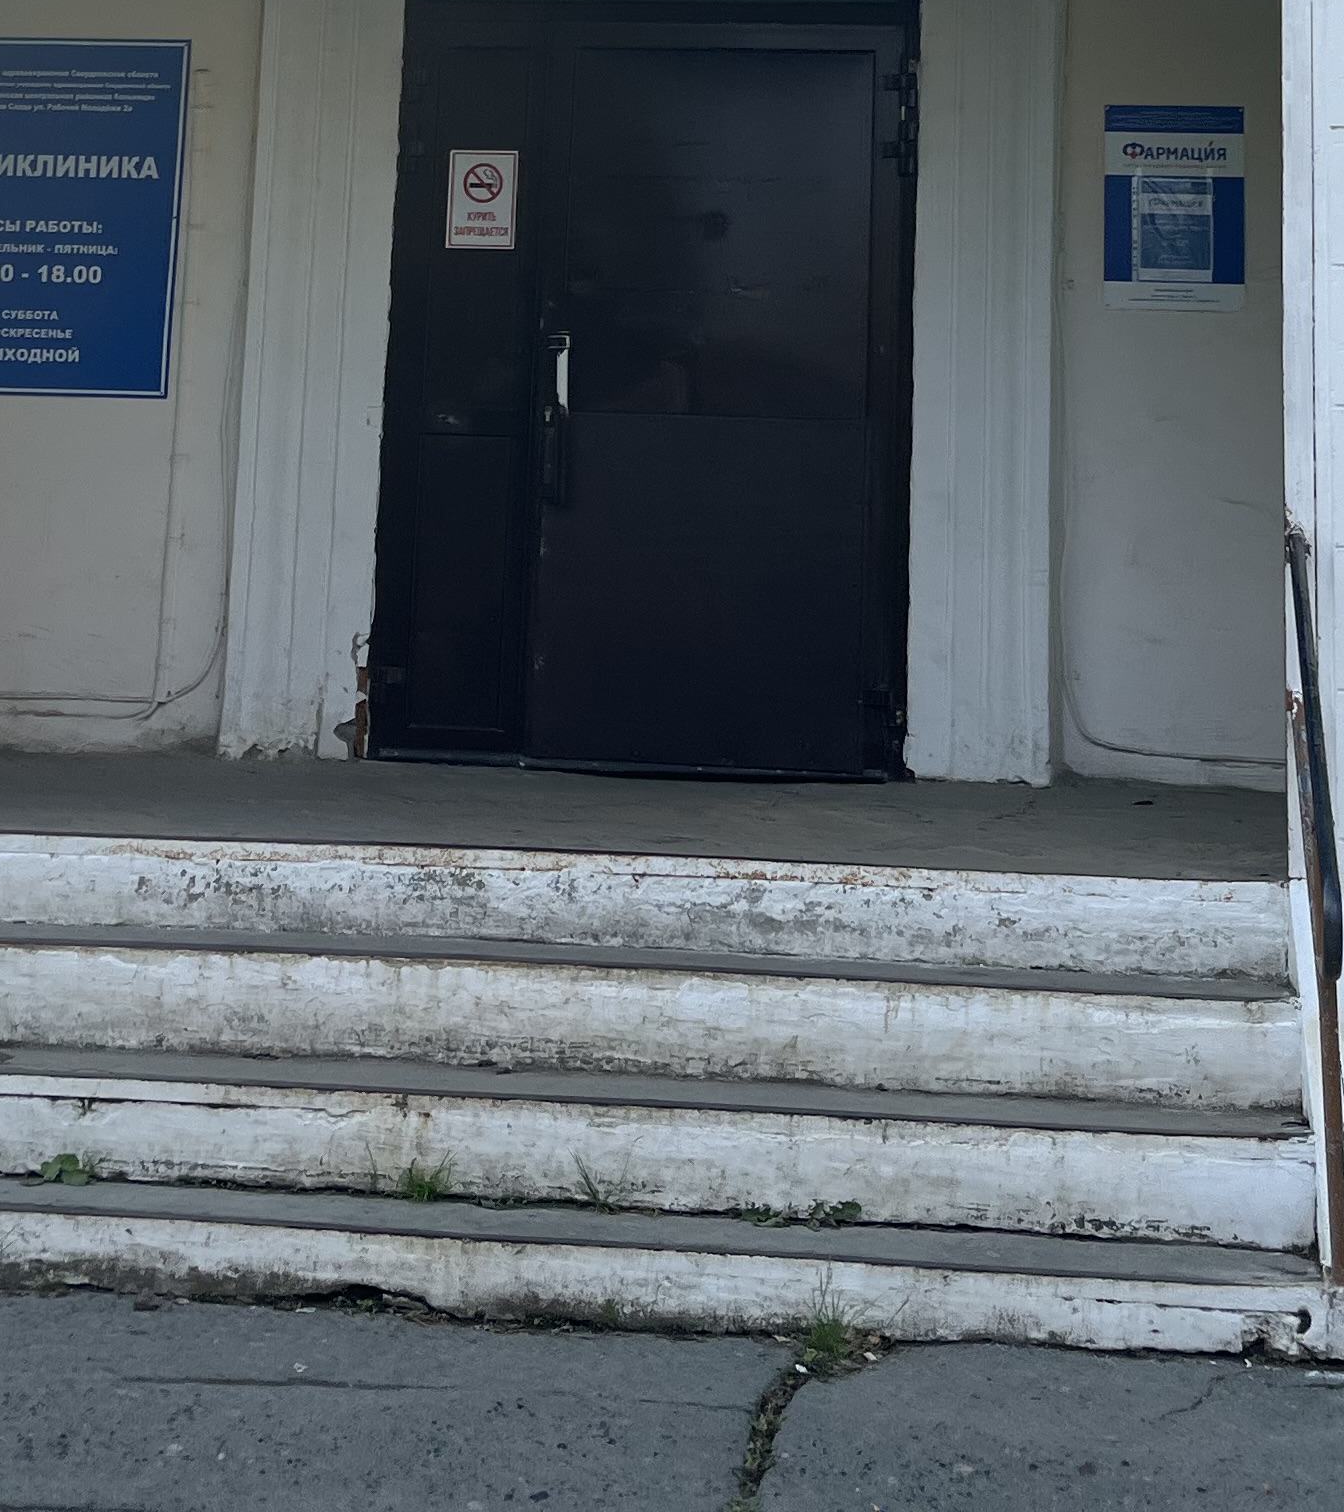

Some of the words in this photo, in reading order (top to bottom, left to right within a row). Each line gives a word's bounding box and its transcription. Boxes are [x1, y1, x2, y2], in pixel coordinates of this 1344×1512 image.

[1122, 141, 1227, 162] ФАРМАЦИЯ
[25, 220, 103, 234] РАБОТЫ:
[37, 265, 102, 284] 18.00
[1, 310, 59, 320] СУББОТА
